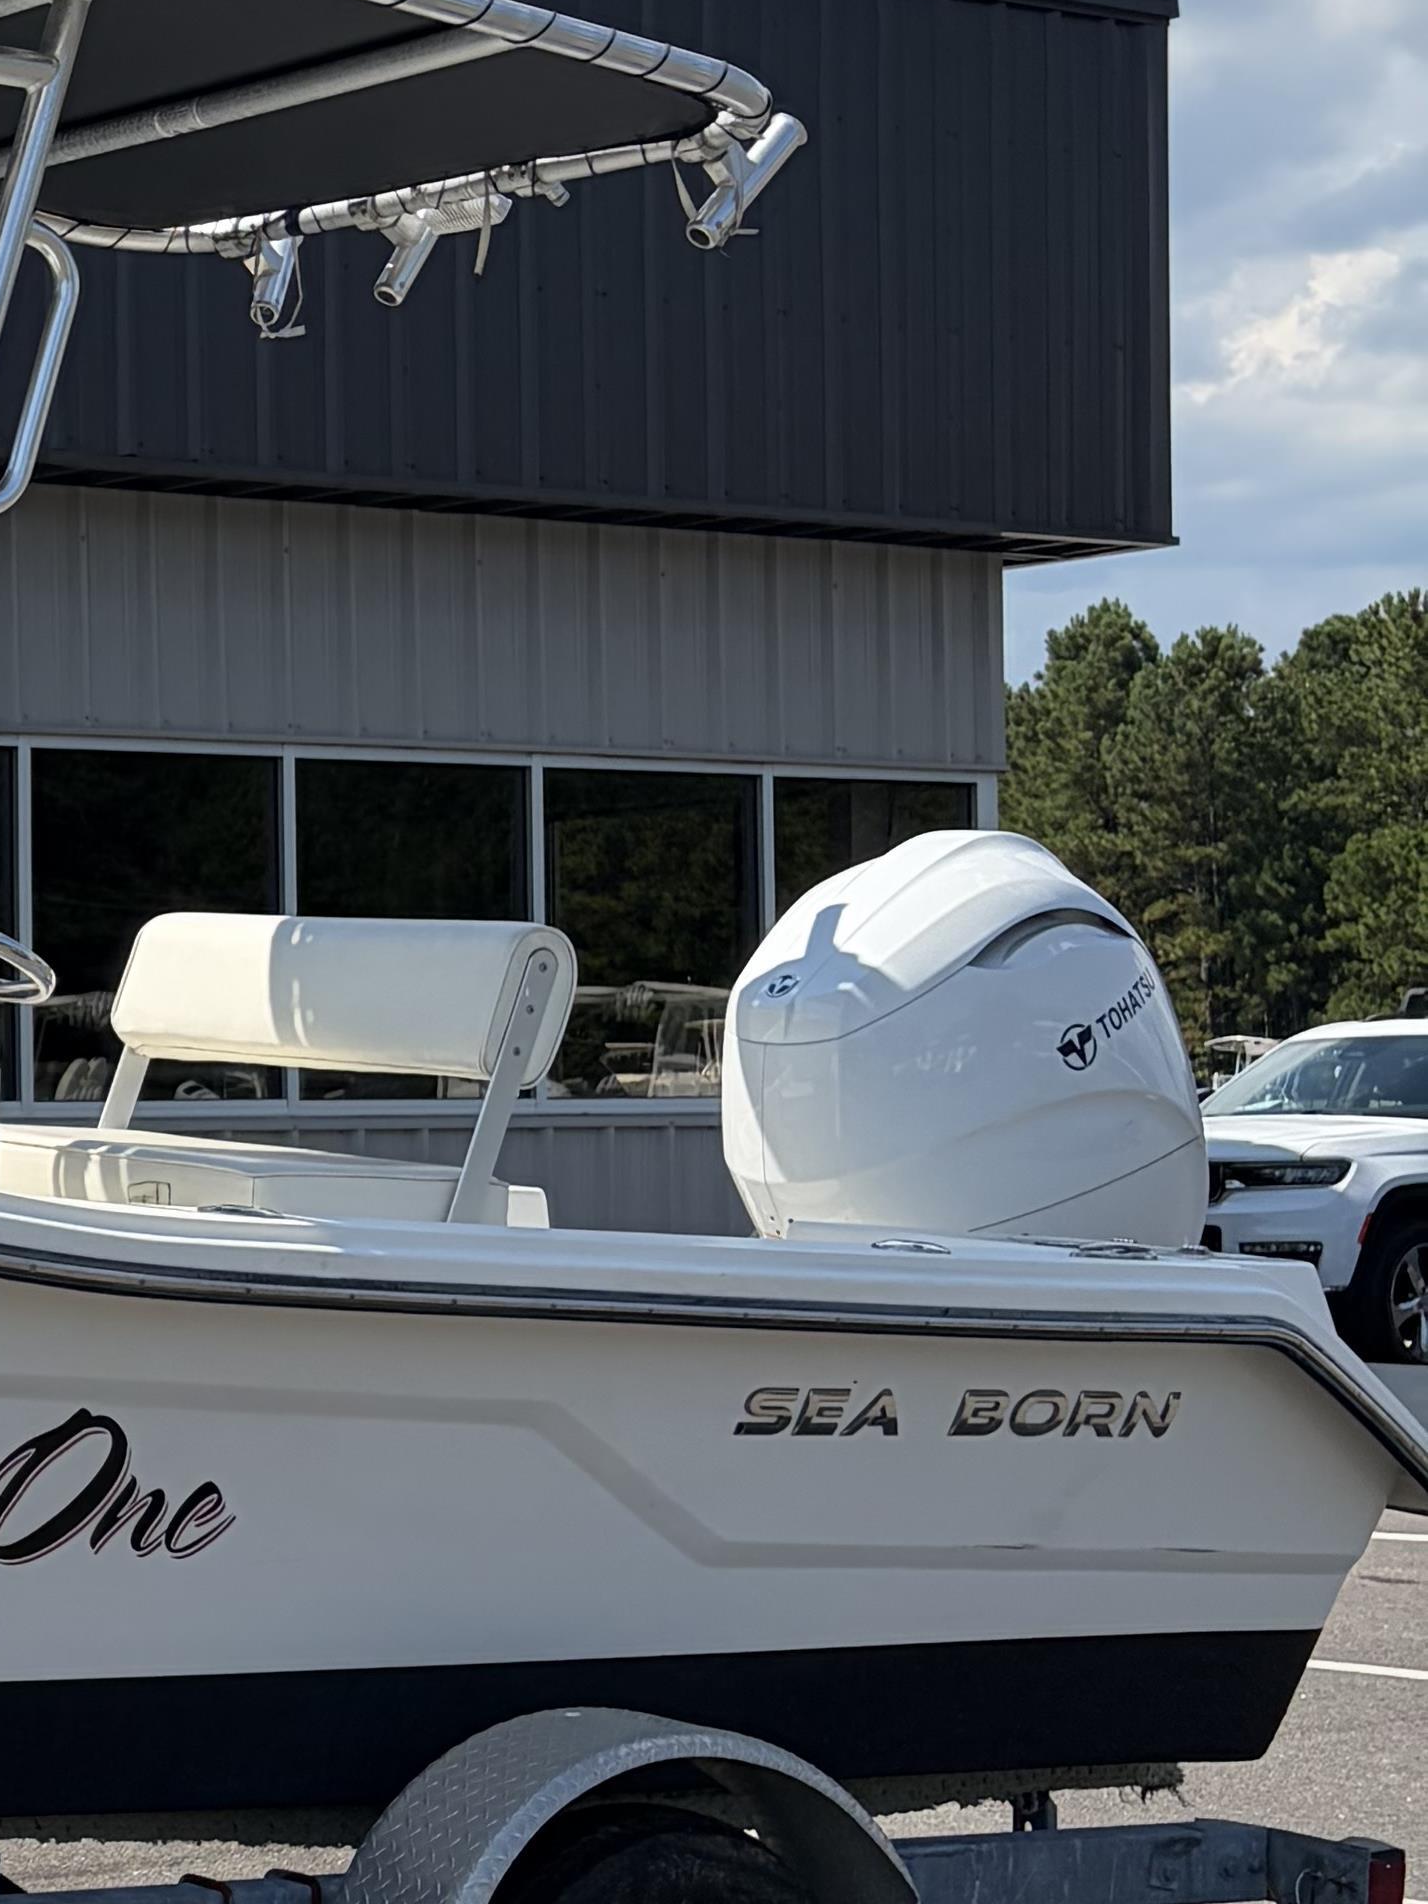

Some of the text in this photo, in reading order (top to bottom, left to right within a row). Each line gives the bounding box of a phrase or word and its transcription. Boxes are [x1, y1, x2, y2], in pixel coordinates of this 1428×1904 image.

[1095, 965, 1156, 1039] TOHATSU
[732, 1385, 1182, 1439] SEA BORN
